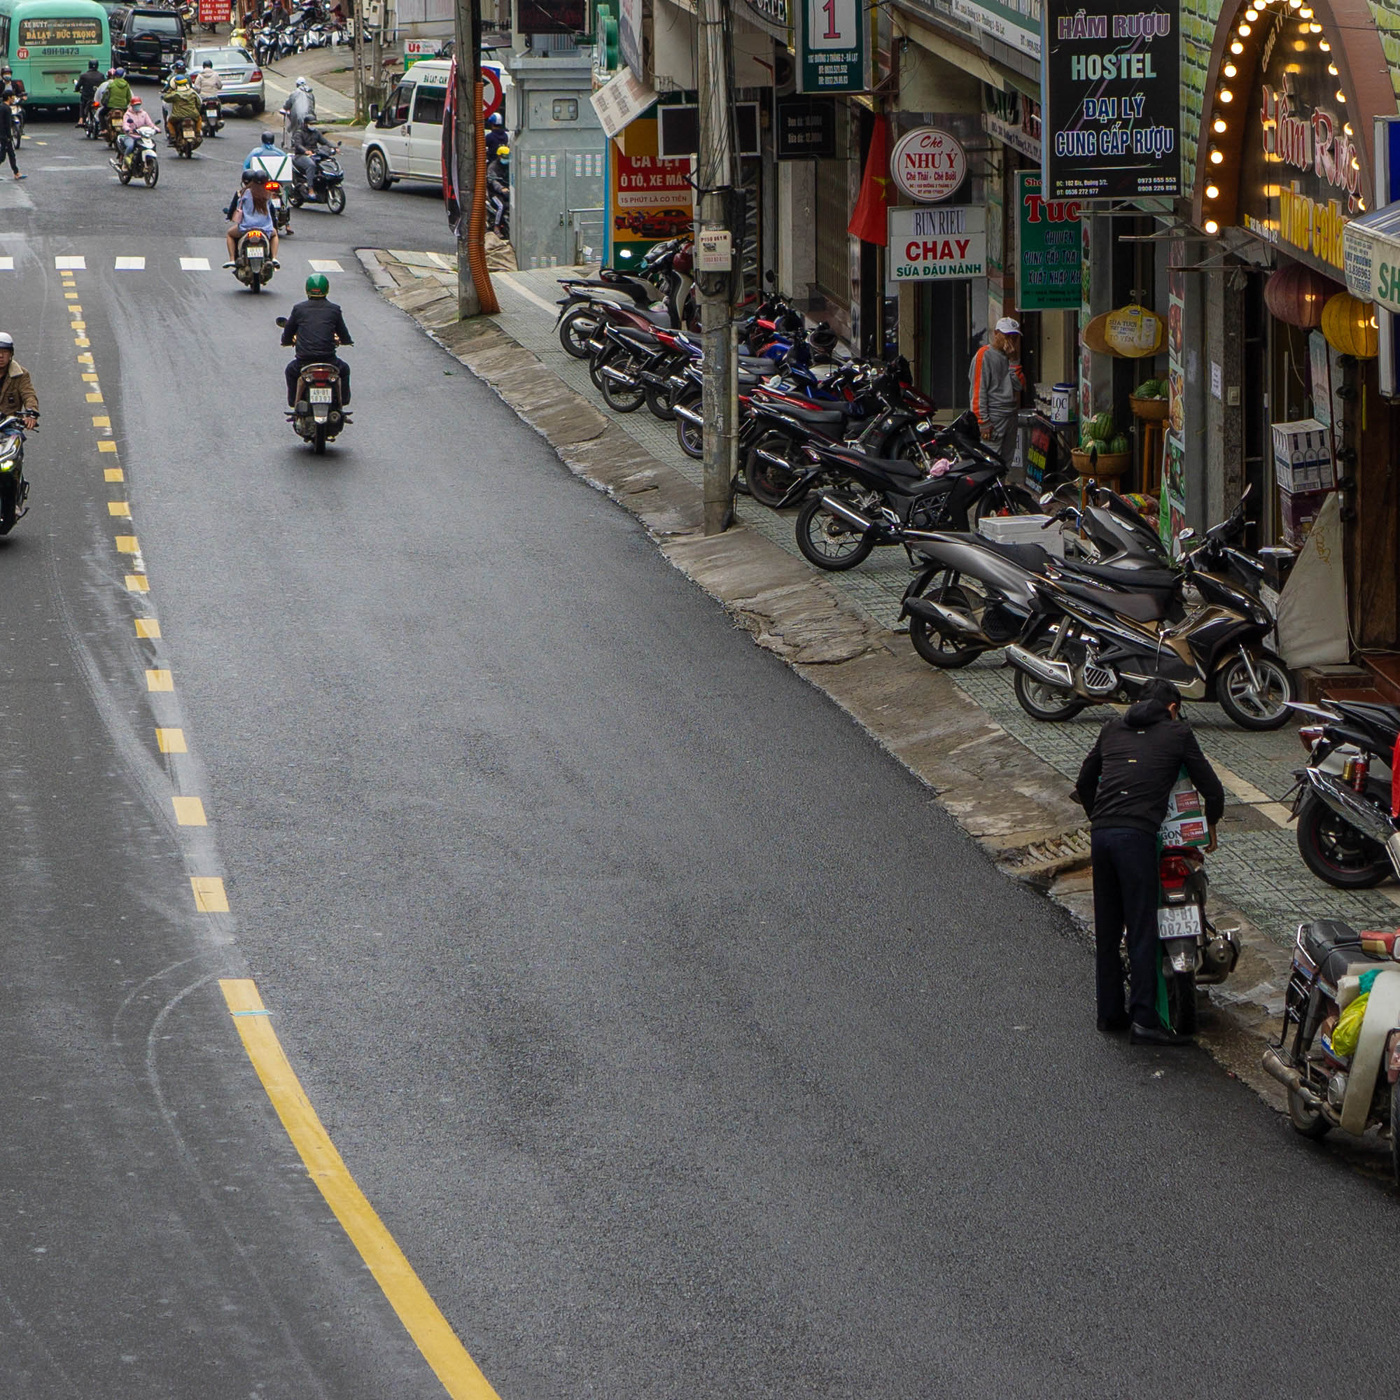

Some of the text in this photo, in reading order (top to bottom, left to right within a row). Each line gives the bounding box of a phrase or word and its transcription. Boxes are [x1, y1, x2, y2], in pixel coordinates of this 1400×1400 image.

[1057, 8, 1171, 43] HẦM RƯỢU
[1071, 52, 1158, 81] HOSTEL
[1083, 92, 1146, 124] ĐẠI LÝ
[1260, 72, 1311, 173] Hầm
[919, 135, 944, 149] Chè
[1054, 130, 1097, 157] CUNG
[1098, 121, 1131, 157] CẤP
[1132, 125, 1175, 159] RƯỢU
[904, 149, 959, 169] NHƯ Ý
[649, 174, 664, 186] XE
[629, 194, 648, 204] PHÚT
[905, 239, 971, 262] CHAY
[896, 262, 982, 277] SỮA ĐẬU NÀNH
